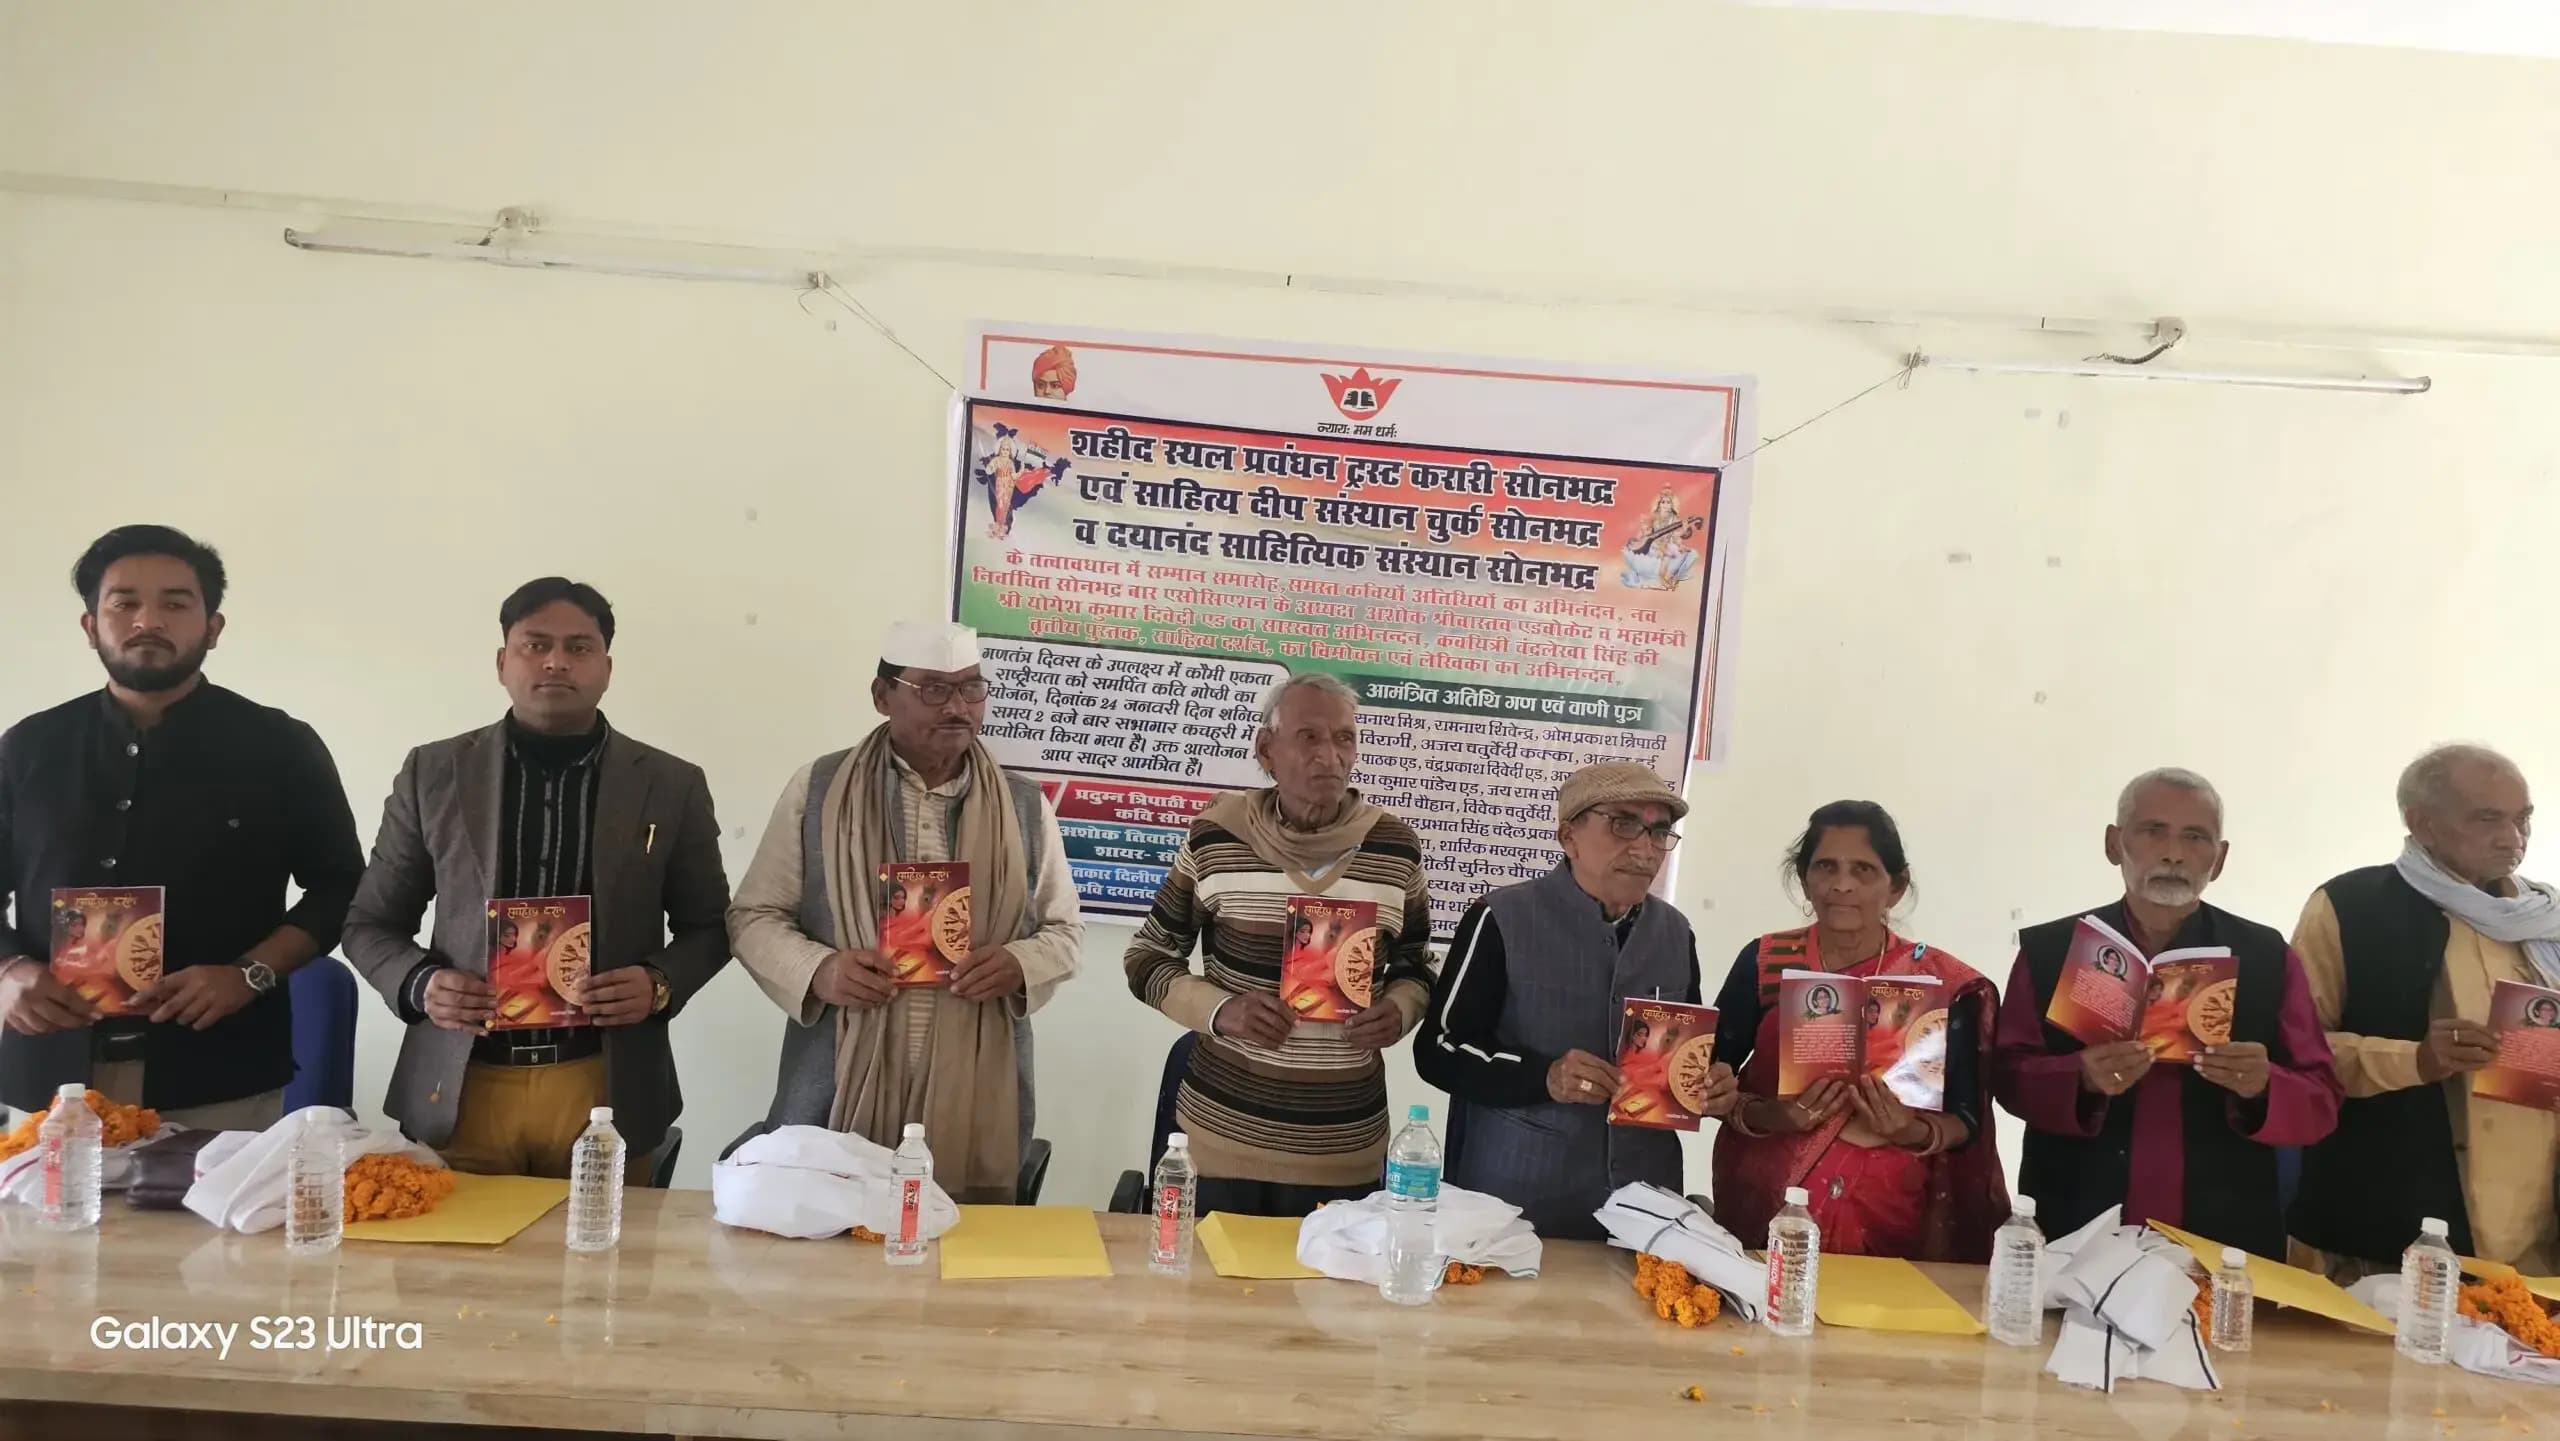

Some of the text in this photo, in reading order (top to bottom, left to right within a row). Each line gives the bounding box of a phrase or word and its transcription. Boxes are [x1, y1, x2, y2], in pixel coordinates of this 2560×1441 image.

[1353, 425, 1373, 436] मम
[1070, 427, 1157, 462] शहीद
[1163, 440, 1236, 470] स्थल
[1345, 458, 1403, 488] ट्रस्ट
[1408, 462, 1497, 493] करारी
[1503, 466, 1617, 504] सोनभद्र
[1077, 472, 1602, 546] एवं साहित्य दीप संस्थान चुर्क सोनभद्र
[1073, 519, 1599, 589] व दयानंद साहित्यिक संस्थान सोनभद्र
[1006, 549, 1023, 565] के
[1126, 561, 1140, 577] में
[1148, 565, 1206, 583] सम्मान
[1346, 583, 1407, 601] कवियों
[1412, 589, 1497, 609] अतिथियों
[1503, 598, 1529, 612] का
[1631, 609, 1660, 624] नव
[973, 566, 1051, 588] निर्वाचित
[1056, 576, 1122, 597] सोनभद्र
[1164, 587, 1267, 610] एसोसिएशन
[1273, 596, 1291, 612] के
[1366, 606, 1427, 624] अशोक
[1433, 610, 1512, 632] श्रीवास्तव
[1617, 629, 1689, 647] महामंत्री
[999, 592, 1020, 608] श्री
[1028, 595, 1082, 614] योगेश
[1088, 603, 1139, 621] कुमार
[1202, 613, 1226, 628] एड
[1231, 615, 1257, 630] का
[1594, 645, 1629, 665] सिंह
[1634, 650, 1661, 665] की
[1037, 648, 1081, 669] दिवस
[1085, 654, 1103, 669] के
[1107, 660, 1164, 678] उपलक्ष्य
[1167, 661, 1182, 678] में
[1185, 663, 1225, 681] कौमी
[1229, 671, 1274, 686] एकता
[1152, 628, 1219, 649] साहित्य
[1280, 642, 1307, 656] का
[1310, 642, 1381, 662] विमोचन
[1388, 650, 1413, 667] एवं
[1419, 653, 1491, 672] लेखिका
[1495, 660, 1521, 675] का
[995, 665, 1257, 703] राष्ट्रीयता को समर्पित कवि गोष्ठी का
[1366, 682, 1644, 723] आमंत्रित अतिथि गण एवं वाणी पुत्र
[988, 684, 1264, 723] योजन, दिनांक 24 जनवरी दिन शनिव
[978, 722, 1046, 741] आयोजित
[1050, 726, 1090, 745] किया
[1094, 735, 1126, 749] गया
[1152, 740, 1182, 754] उक्त
[1184, 741, 1249, 760] आयोजन
[991, 706, 1256, 741] समय 2 बजे बार सभागार कचहरी में
[1354, 713, 1395, 726] सनाथ
[1434, 720, 1487, 734] रामनाथ
[1621, 732, 1667, 751] त्रिपाठी
[1041, 749, 1073, 763] आप
[1076, 751, 1119, 769] सादर
[1122, 754, 1182, 773] आमंत्रित
[1362, 753, 1397, 767] पाठक
[1421, 739, 1462, 753] अजय
[1466, 741, 1518, 760] चतुर्वेदी
[1129, 791, 1187, 809] त्रिपाठी
[1378, 775, 1418, 790] कुमार
[1487, 785, 1512, 796] जय
[1514, 787, 1539, 799] राम
[1114, 807, 1155, 822] कवि
[1463, 798, 1503, 816] विवेक
[1060, 825, 1120, 839] अशोक
[1461, 818, 1490, 837] सिंह
[1070, 867, 1162, 885] तकार दिलीप
